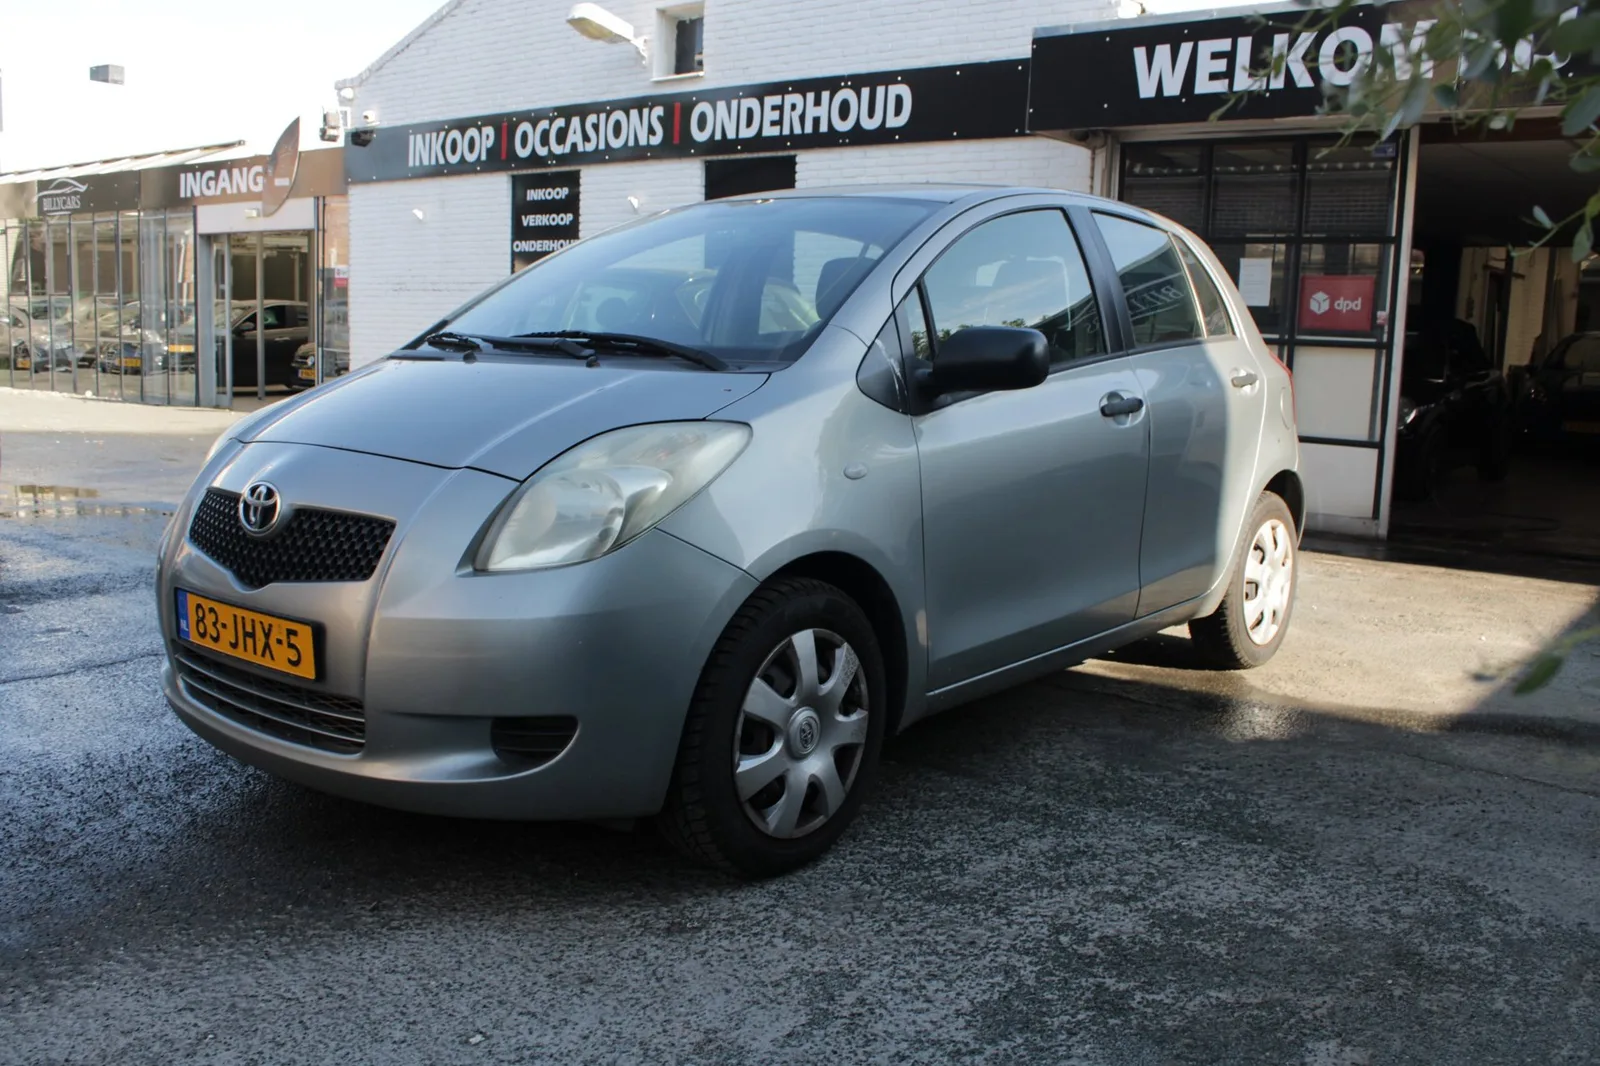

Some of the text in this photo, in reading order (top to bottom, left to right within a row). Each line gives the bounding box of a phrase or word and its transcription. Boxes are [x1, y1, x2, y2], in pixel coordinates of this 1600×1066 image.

[408, 83, 912, 167] INKOOP OCCASIONS ONDERHOUD
[180, 165, 264, 198] INGANG
[526, 187, 569, 201] INKOOP
[521, 213, 573, 227] VERKOOP
[1334, 297, 1362, 313] dpd
[180, 619, 189, 631] NL
[195, 603, 302, 667] 83-JHX-5
